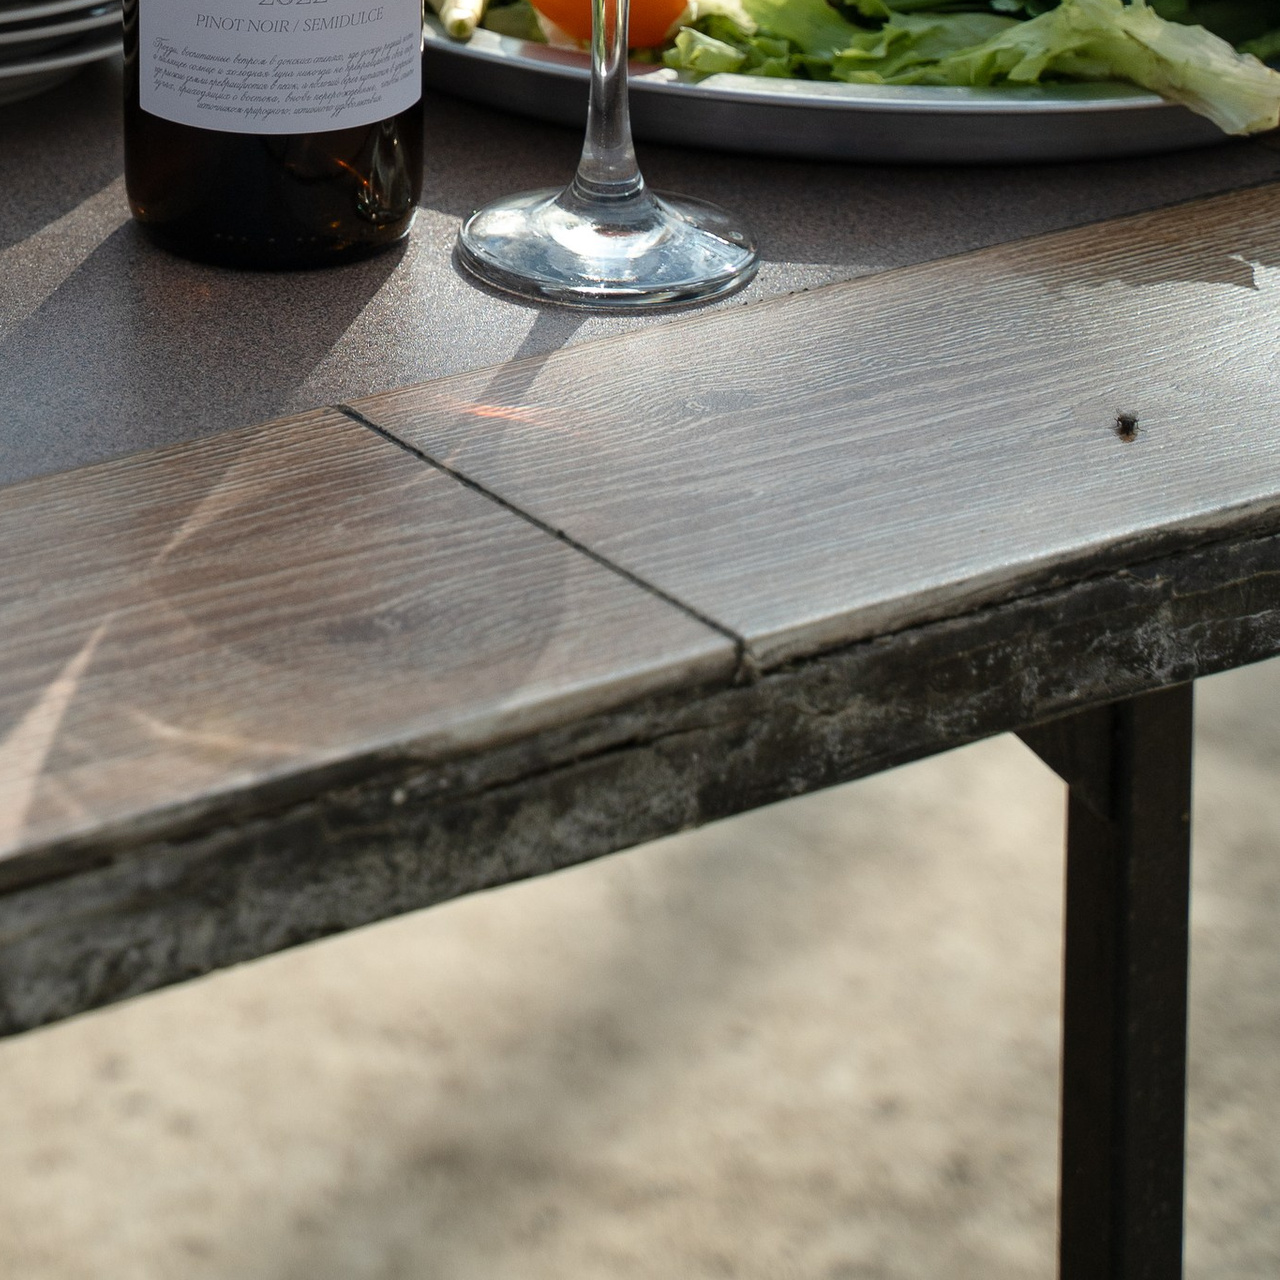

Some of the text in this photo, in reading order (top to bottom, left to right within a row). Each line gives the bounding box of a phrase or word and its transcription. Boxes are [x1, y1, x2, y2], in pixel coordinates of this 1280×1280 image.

[196, 14, 245, 32] PINOT
[247, 20, 290, 33] NOIR
[303, 7, 384, 32] SEMIDULCE
